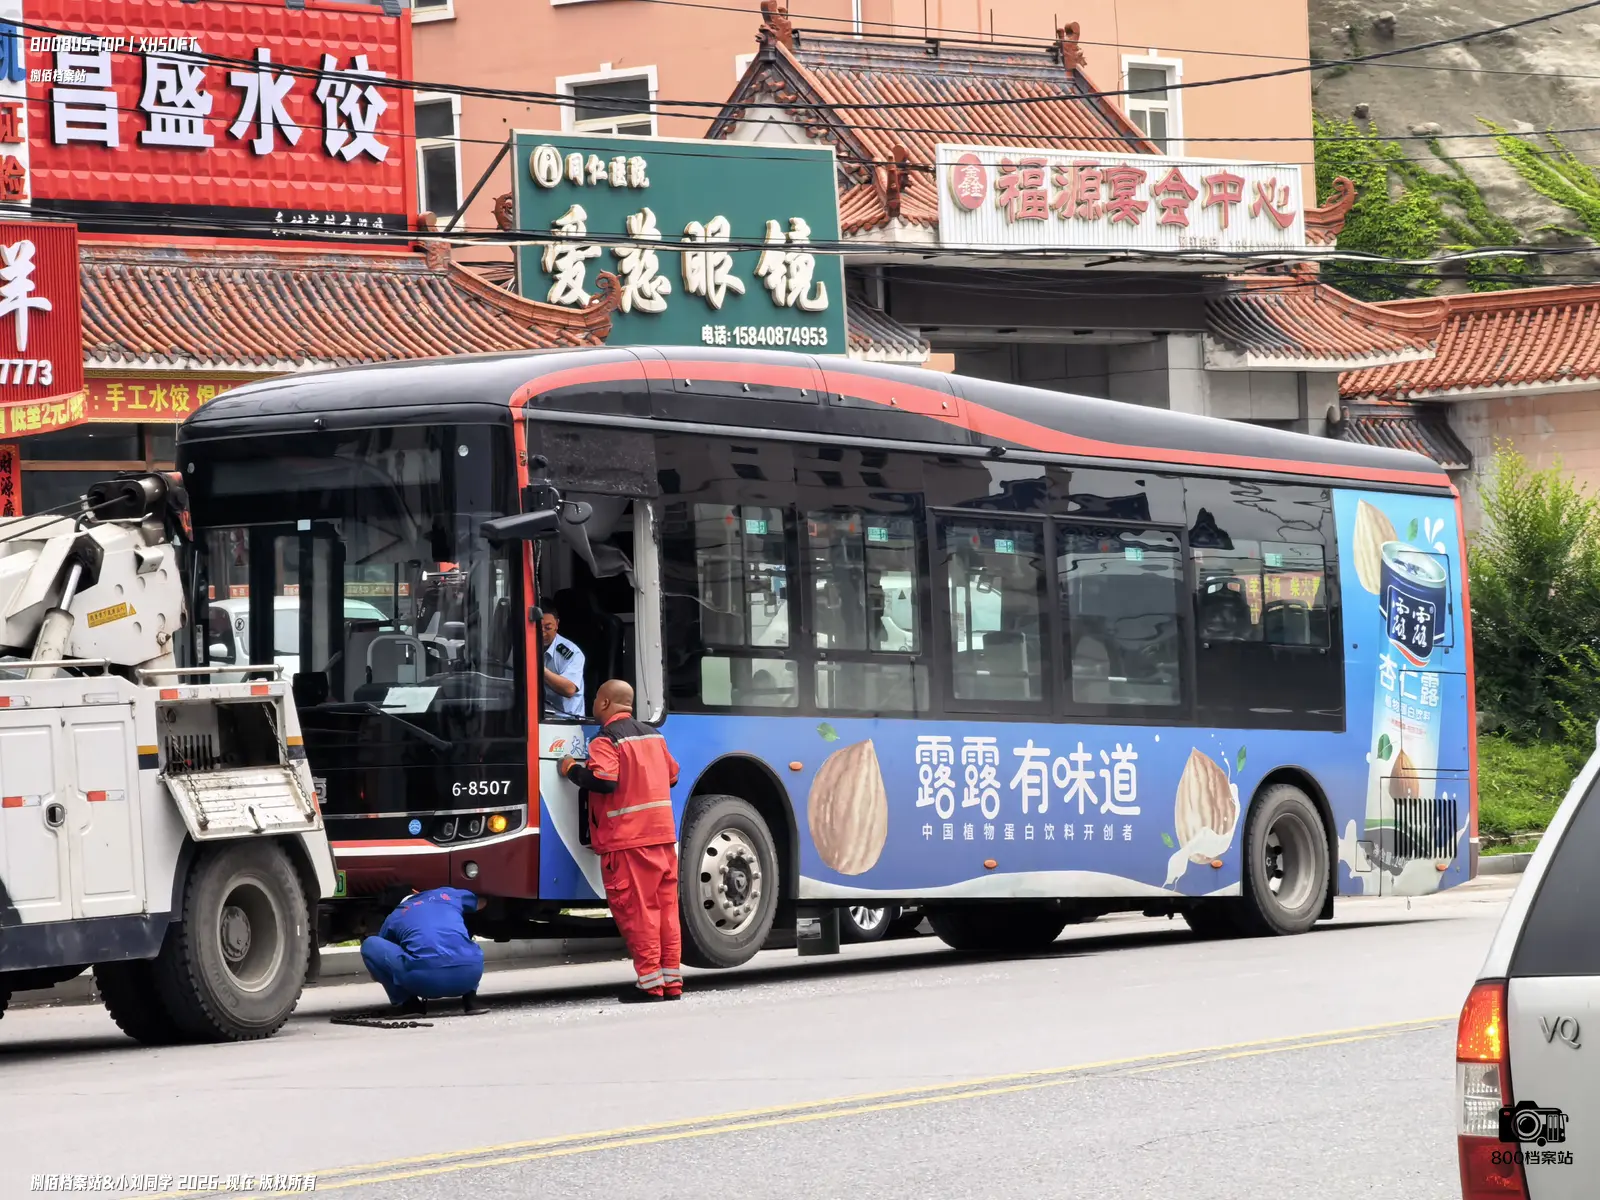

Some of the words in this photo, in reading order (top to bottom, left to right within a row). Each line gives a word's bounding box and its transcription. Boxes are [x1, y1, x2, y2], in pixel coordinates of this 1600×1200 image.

[51, 36, 391, 163] 昌盛水饺
[995, 156, 1297, 230] 福源宴会中心
[1378, 652, 1440, 707] 杏仁露
[452, 780, 511, 797] 6-8507
[915, 735, 1141, 821] 露露有味道
[921, 823, 1133, 841] 中国植物蛋白饮料开创者
[1539, 1016, 1581, 1050] VQ
